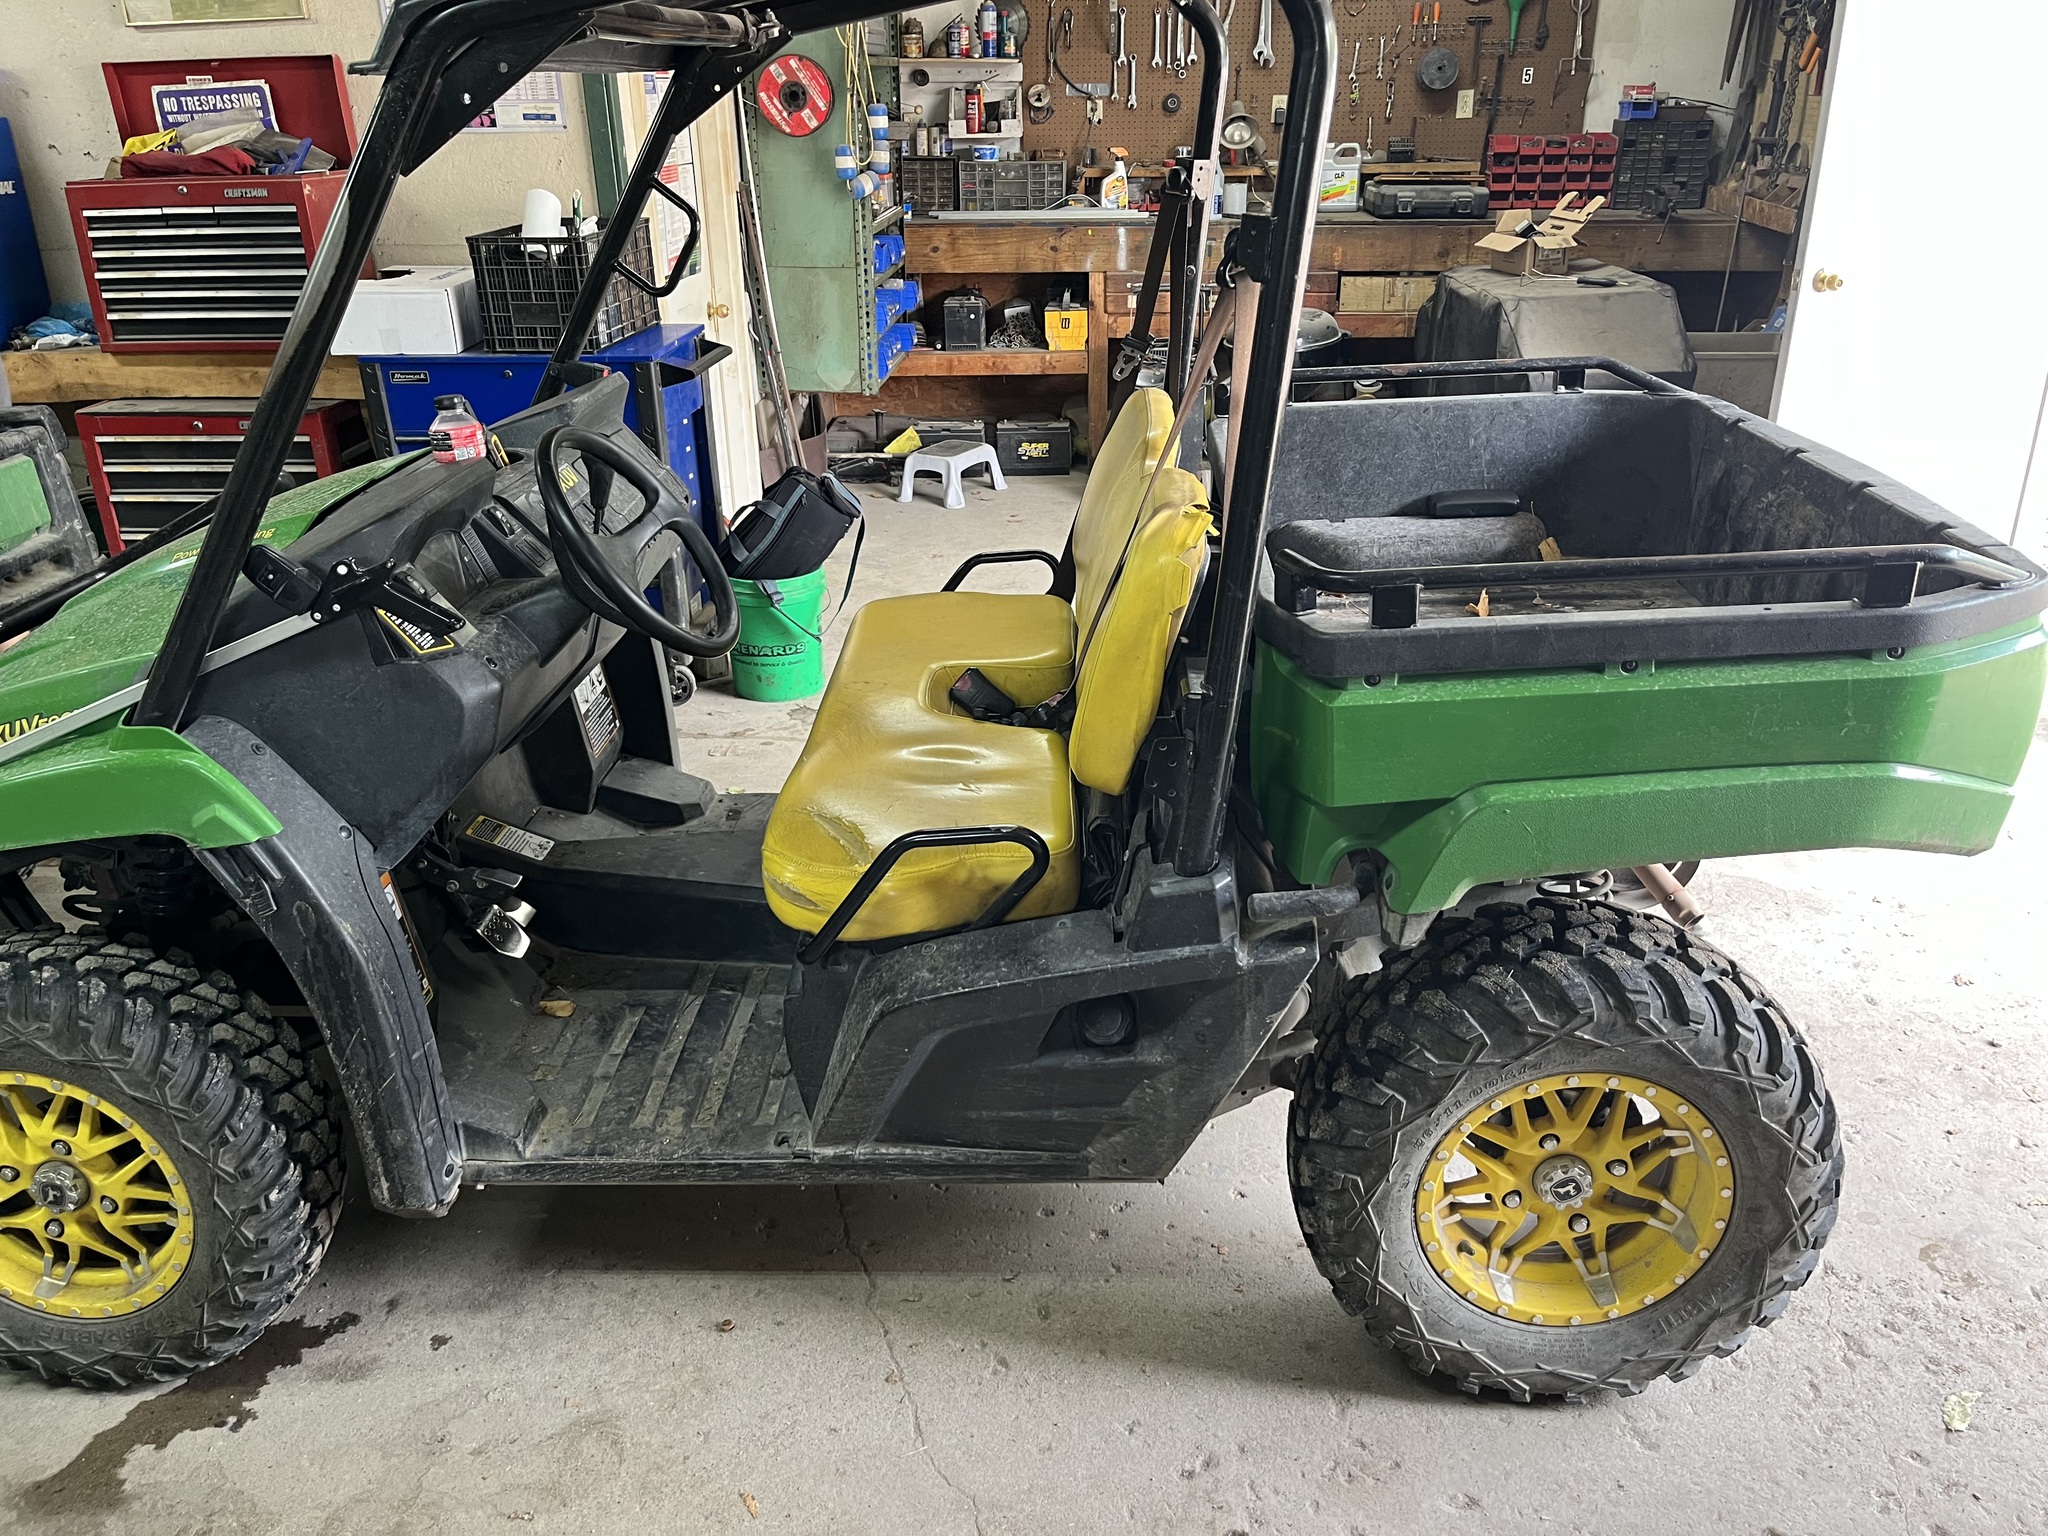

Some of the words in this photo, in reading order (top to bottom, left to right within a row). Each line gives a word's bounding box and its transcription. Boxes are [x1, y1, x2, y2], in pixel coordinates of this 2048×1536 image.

[1523, 68, 1532, 82] 5
[162, 97, 178, 112] NO
[180, 92, 262, 111] TRESPASSING
[166, 113, 192, 123] WITHOUT
[1334, 171, 1345, 179] CLR
[223, 187, 268, 198] CRAFTSMAN
